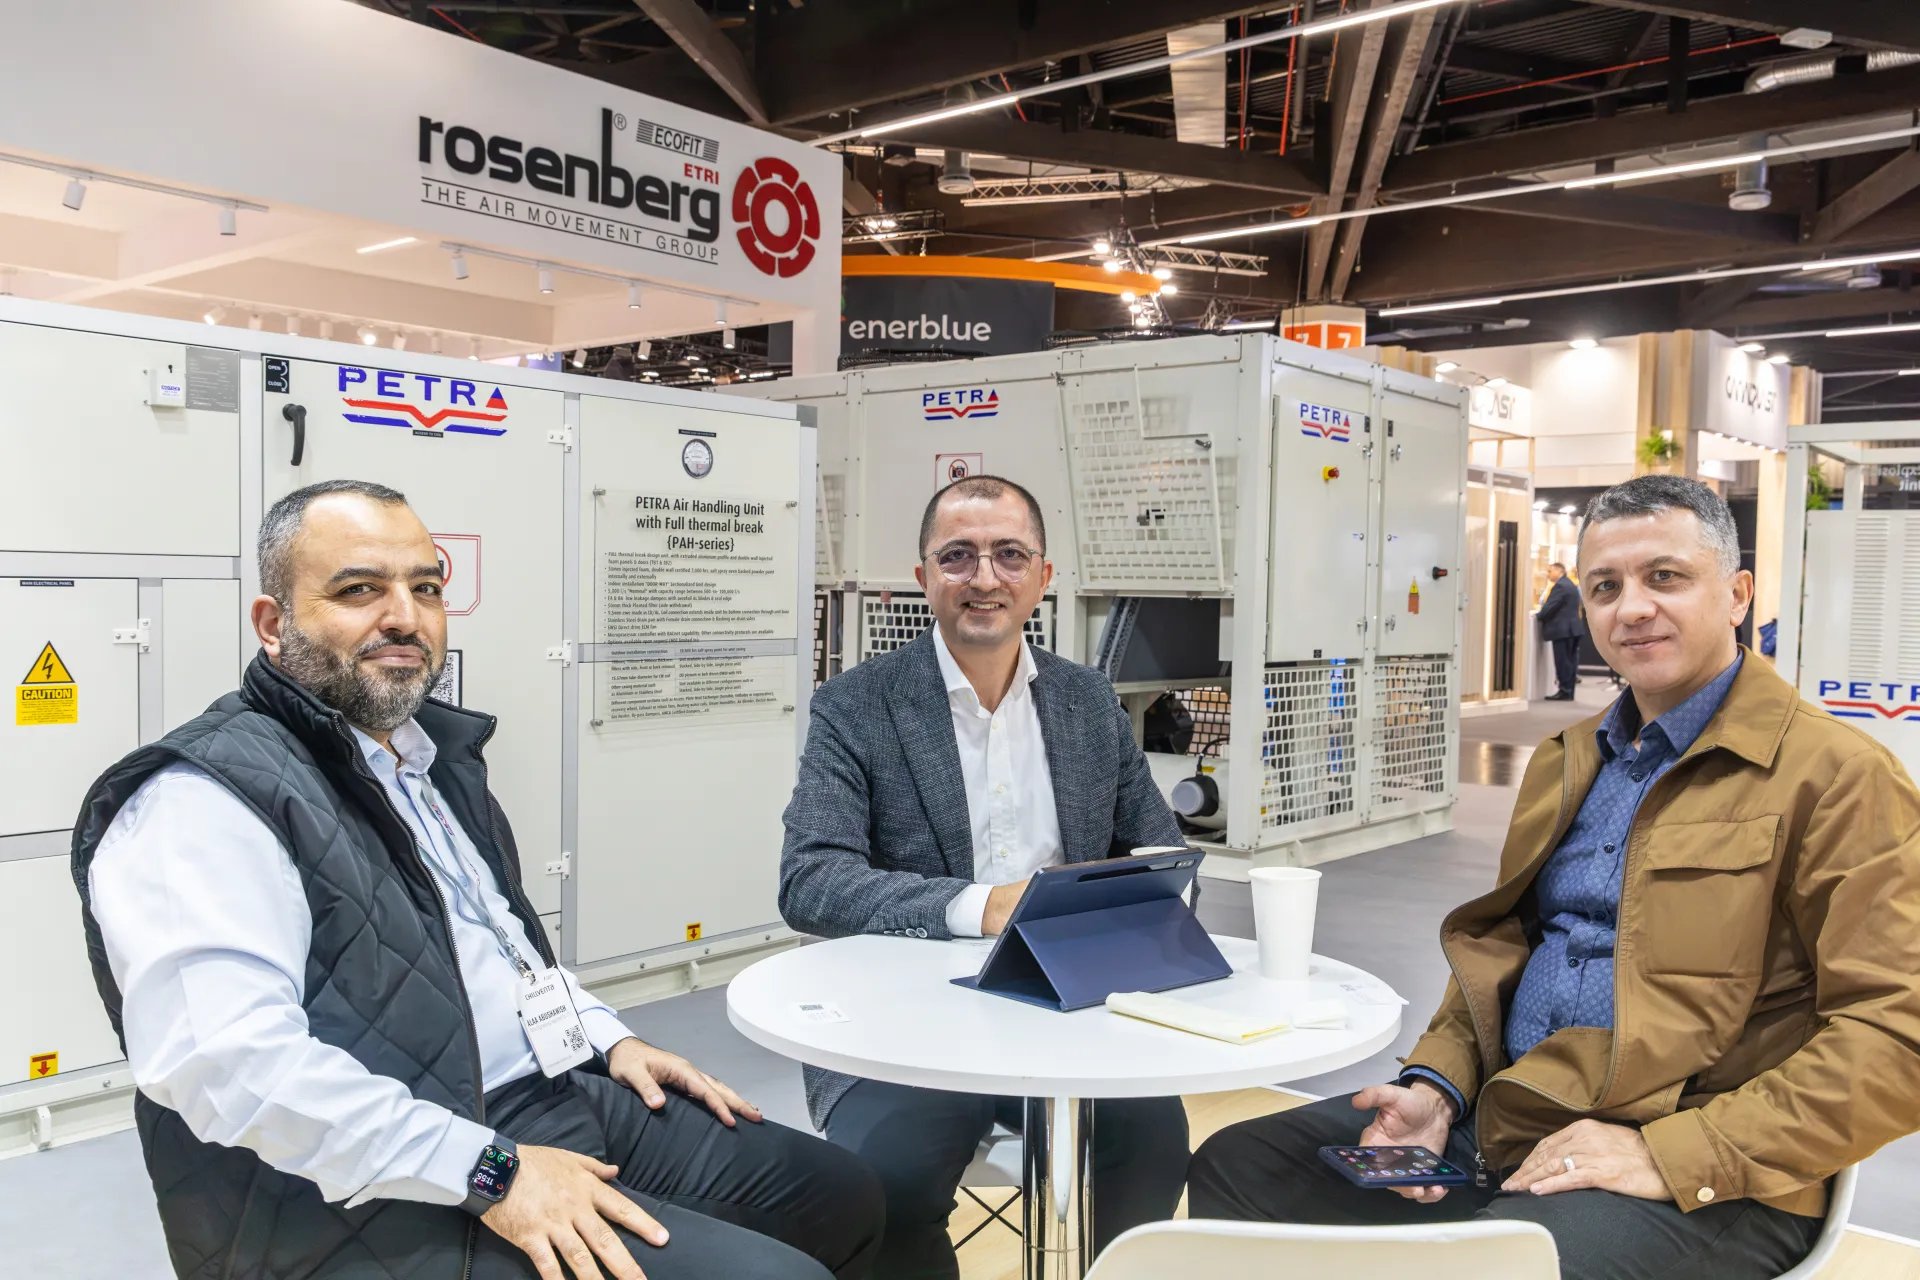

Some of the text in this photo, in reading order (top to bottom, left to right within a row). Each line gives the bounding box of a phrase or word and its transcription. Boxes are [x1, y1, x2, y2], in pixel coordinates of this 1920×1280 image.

[655, 127, 702, 156] ECOFIT
[419, 107, 720, 243] rosenberg
[684, 163, 719, 184] ETRI
[422, 183, 718, 261] THE AIR MOVEMENT GROUP
[848, 314, 992, 341] enerblue
[1338, 332, 1352, 349] 7
[338, 366, 508, 410] PETRA
[923, 389, 999, 407] PETRA
[1300, 403, 1350, 427] PETRA
[636, 496, 764, 517] PETRA Air Handling Unit
[636, 515, 764, 533] with Full thermal break
[667, 535, 734, 552] {PAH-series}
[23, 689, 71, 699] CAUTION
[526, 1016, 538, 1027] ALAA
